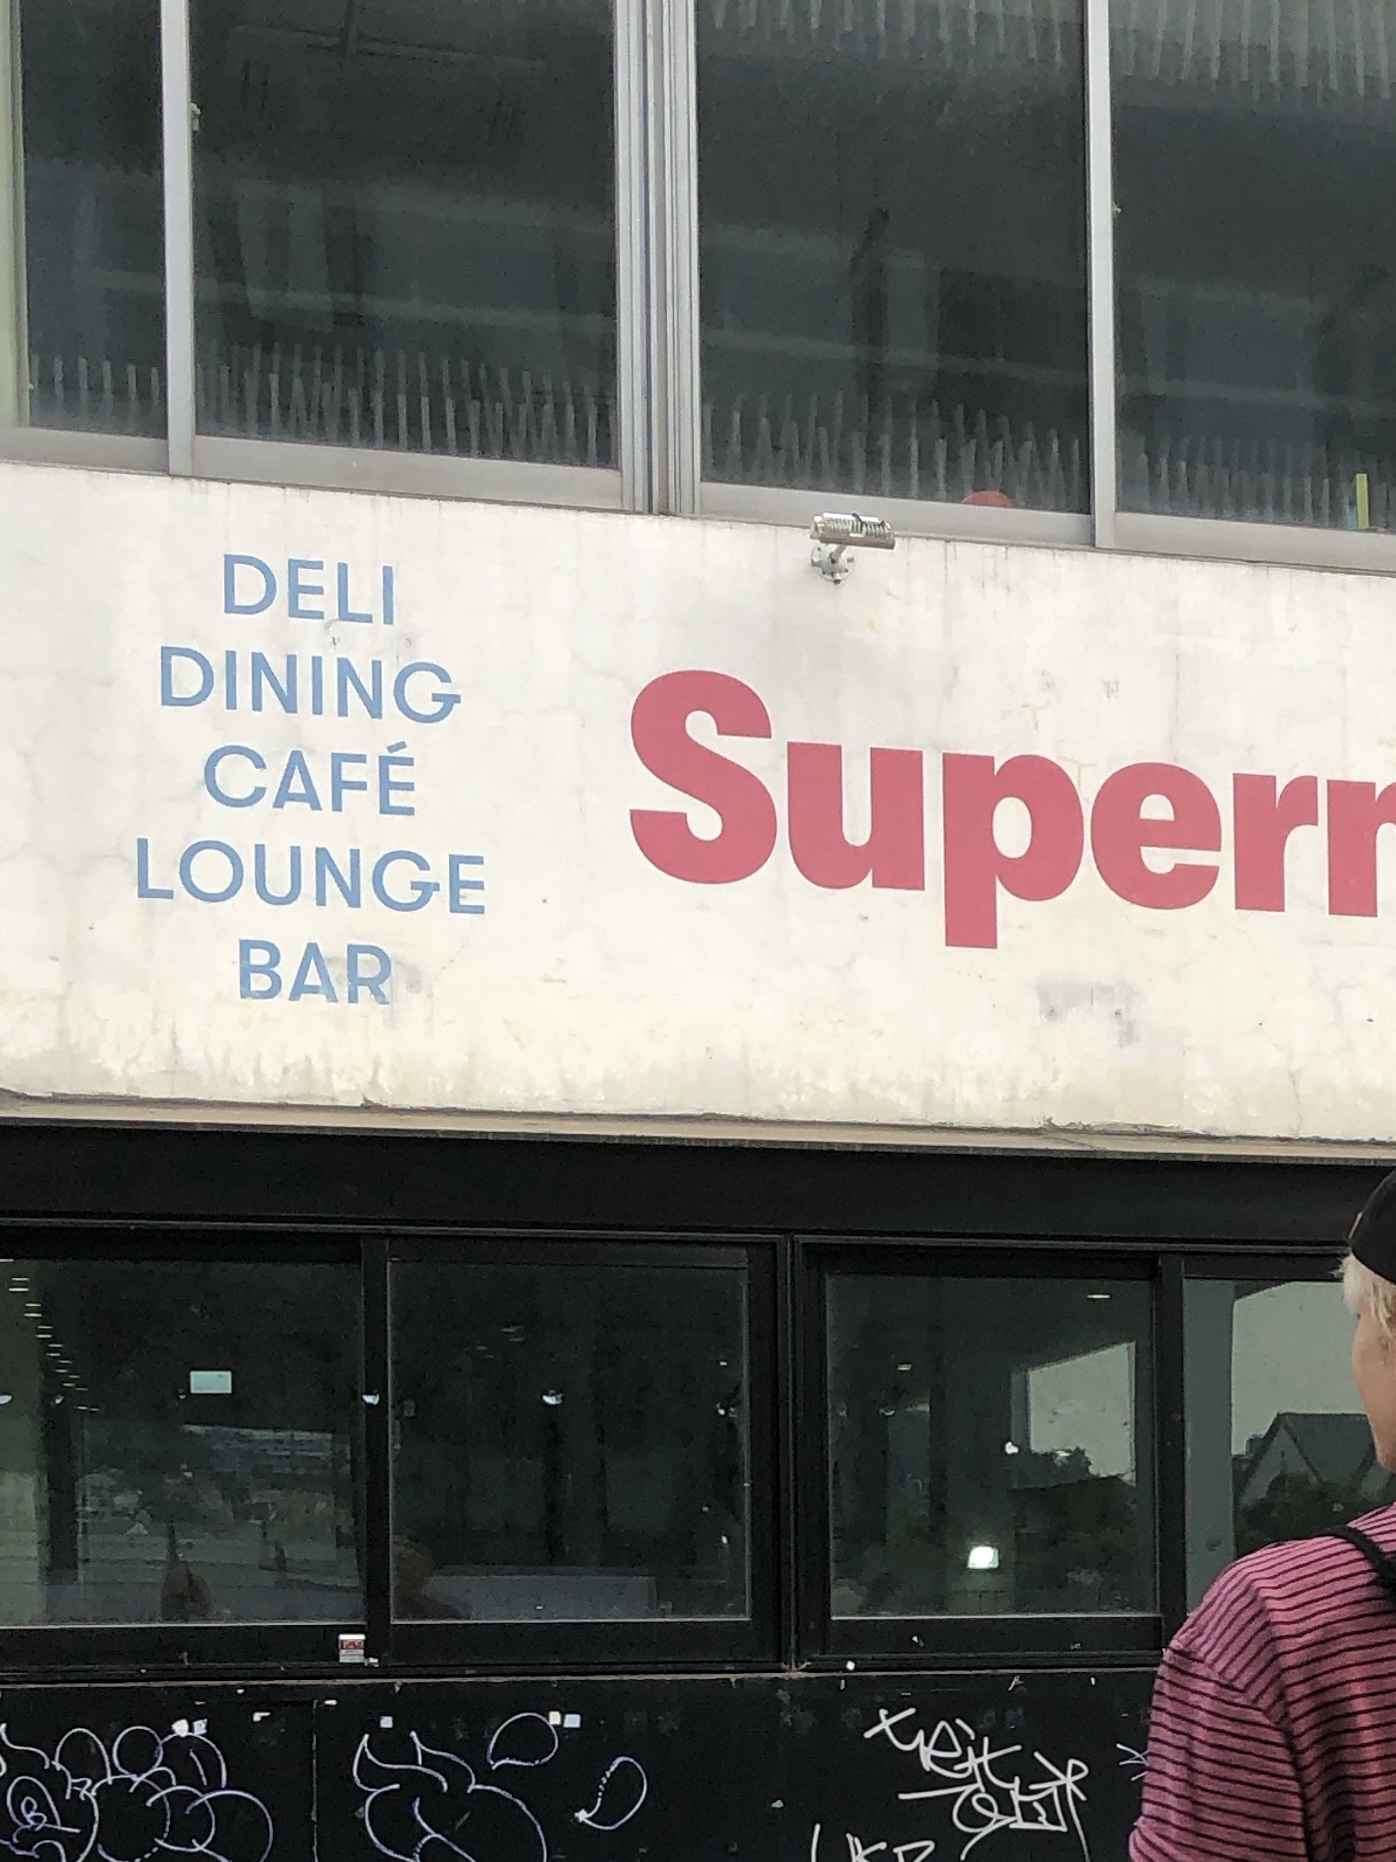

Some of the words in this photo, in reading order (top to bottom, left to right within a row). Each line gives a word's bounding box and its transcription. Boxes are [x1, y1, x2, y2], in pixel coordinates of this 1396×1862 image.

[224, 554, 394, 624] DELI
[161, 646, 460, 722] DINING
[204, 741, 414, 816] CAFÉ
[137, 838, 484, 914] LOUNGE
[239, 940, 391, 1004] BAR
